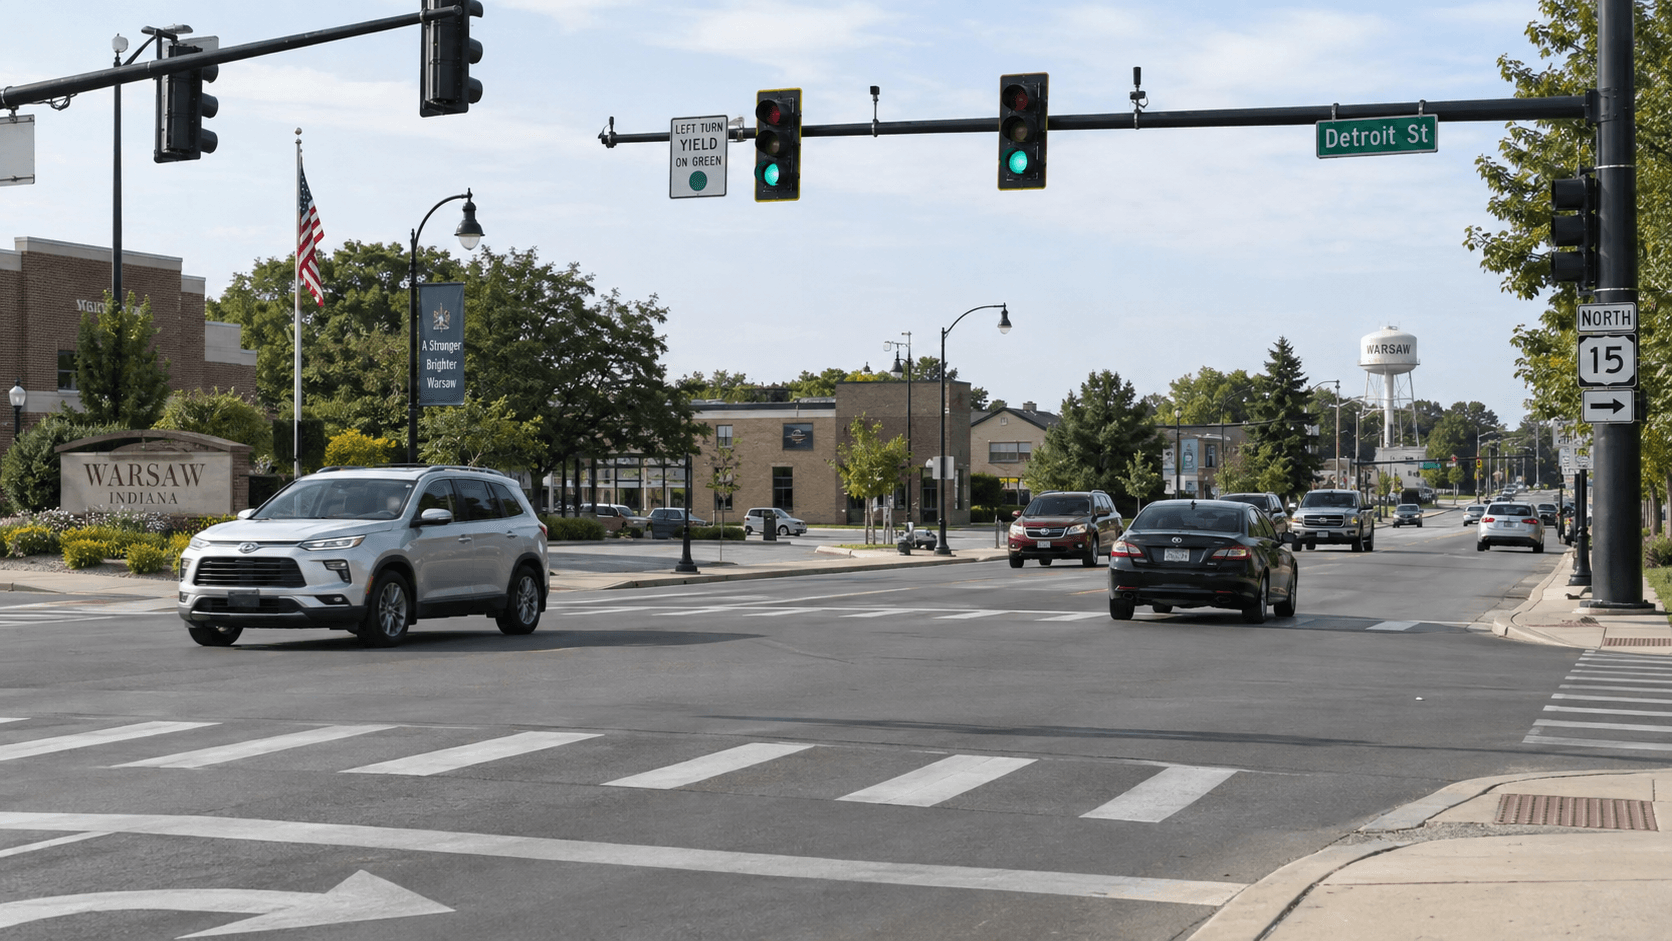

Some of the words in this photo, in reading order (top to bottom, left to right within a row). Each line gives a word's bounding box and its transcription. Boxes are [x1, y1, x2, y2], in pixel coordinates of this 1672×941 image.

[675, 123, 696, 135] LEFT
[700, 122, 723, 133] TURN
[1325, 125, 1396, 148] Detroit
[1407, 123, 1429, 144] St
[680, 137, 718, 151] YIELD
[675, 157, 688, 168] ON
[692, 155, 722, 167] GREEN
[1581, 309, 1631, 327] NORTH
[421, 340, 428, 351] A
[1366, 343, 1411, 355] WARSAW
[426, 358, 458, 372] Brighter
[1590, 345, 1624, 374] 15
[426, 377, 457, 389] Warsaw
[83, 463, 206, 487] WARSAW
[109, 491, 179, 505] INDIANA
